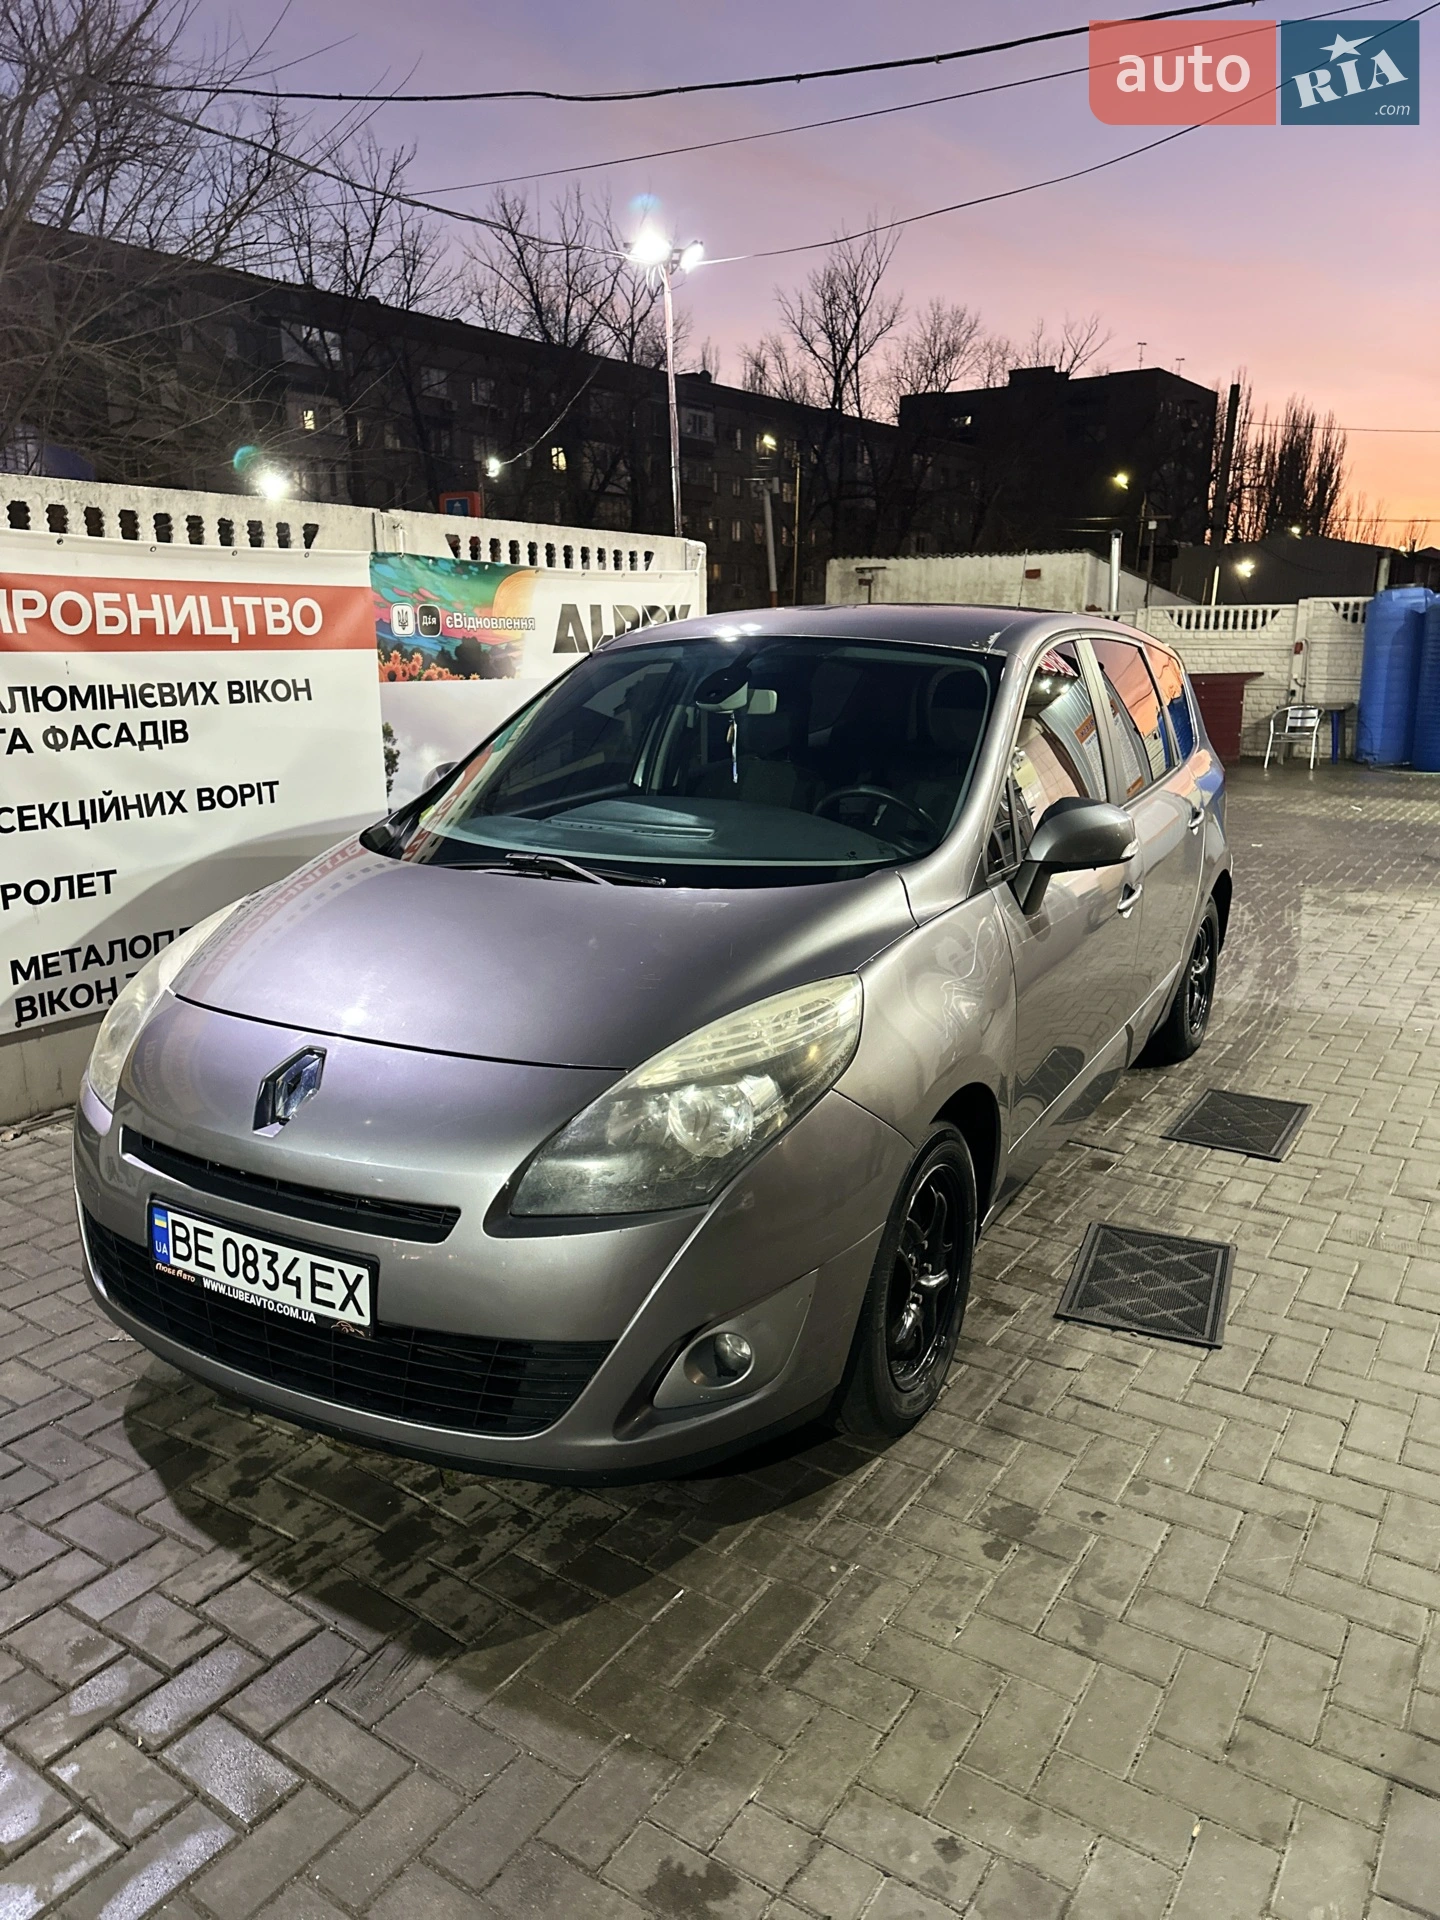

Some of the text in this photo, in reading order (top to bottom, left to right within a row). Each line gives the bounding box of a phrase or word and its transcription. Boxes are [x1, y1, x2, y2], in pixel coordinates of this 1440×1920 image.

[422, 615, 437, 626] Дія
[446, 612, 536, 631] єВідновлення
[0, 678, 313, 715] ЛЮМІНІЄВИХ ВІКОН
[42, 719, 189, 752] ФАСАДІВ
[0, 780, 279, 833] СЕКЦІЙНИХ ВОРІТ
[0, 869, 117, 910] РОЛЕТ
[14, 976, 118, 1022] ВІКОН
[155, 1240, 169, 1256] UA
[171, 1218, 365, 1317] BE 0834 EX
[202, 1277, 316, 1324] WWW.LUBEAVTO.COM.UA
